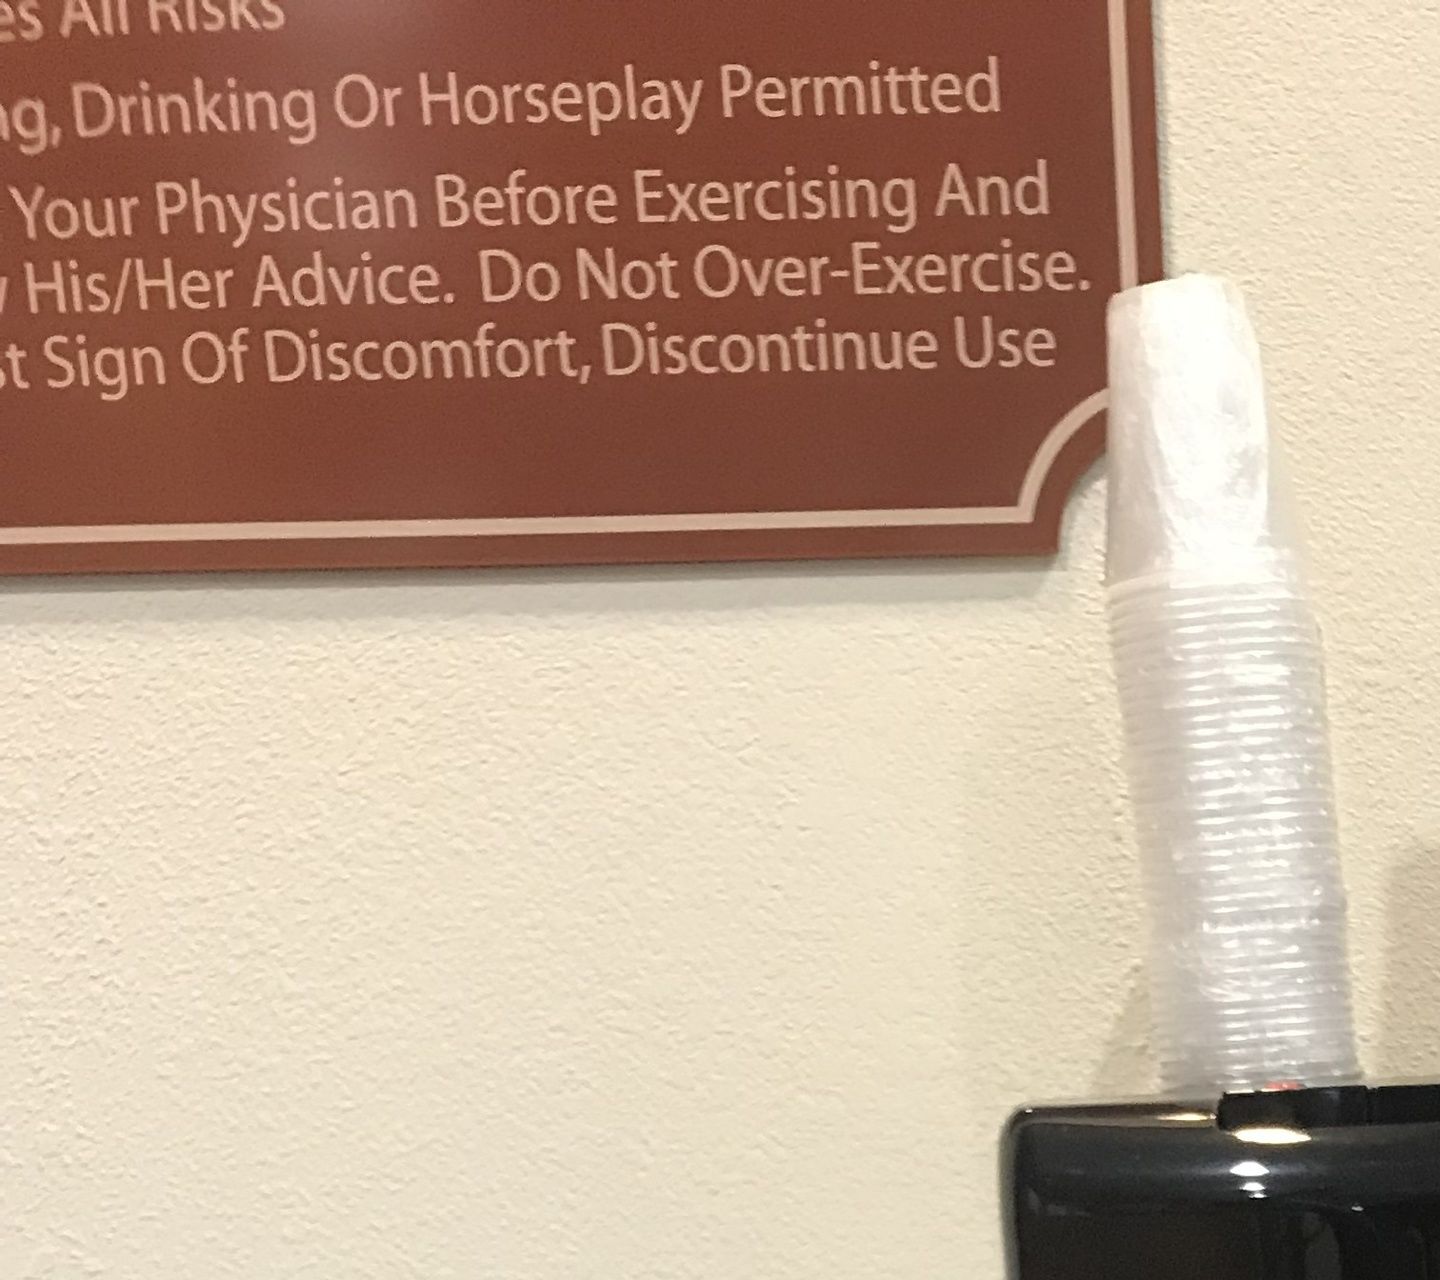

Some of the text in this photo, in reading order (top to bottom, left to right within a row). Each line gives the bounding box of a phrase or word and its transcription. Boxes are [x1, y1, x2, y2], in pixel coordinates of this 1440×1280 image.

[60, 0, 129, 37] All
[148, 0, 284, 33] Risks
[0, 56, 1000, 156] g, Drinking Or Horseplay Permitted
[8, 159, 1049, 248] Your Physician Before Exercising And
[24, 258, 233, 314] His/Her
[252, 251, 454, 307] Advice.
[479, 249, 560, 302] Do
[576, 247, 680, 300] Not
[694, 239, 1090, 298] Over-Exercise.
[0, 316, 1056, 401] t Sign Of Discomfort, Discontinue Use
